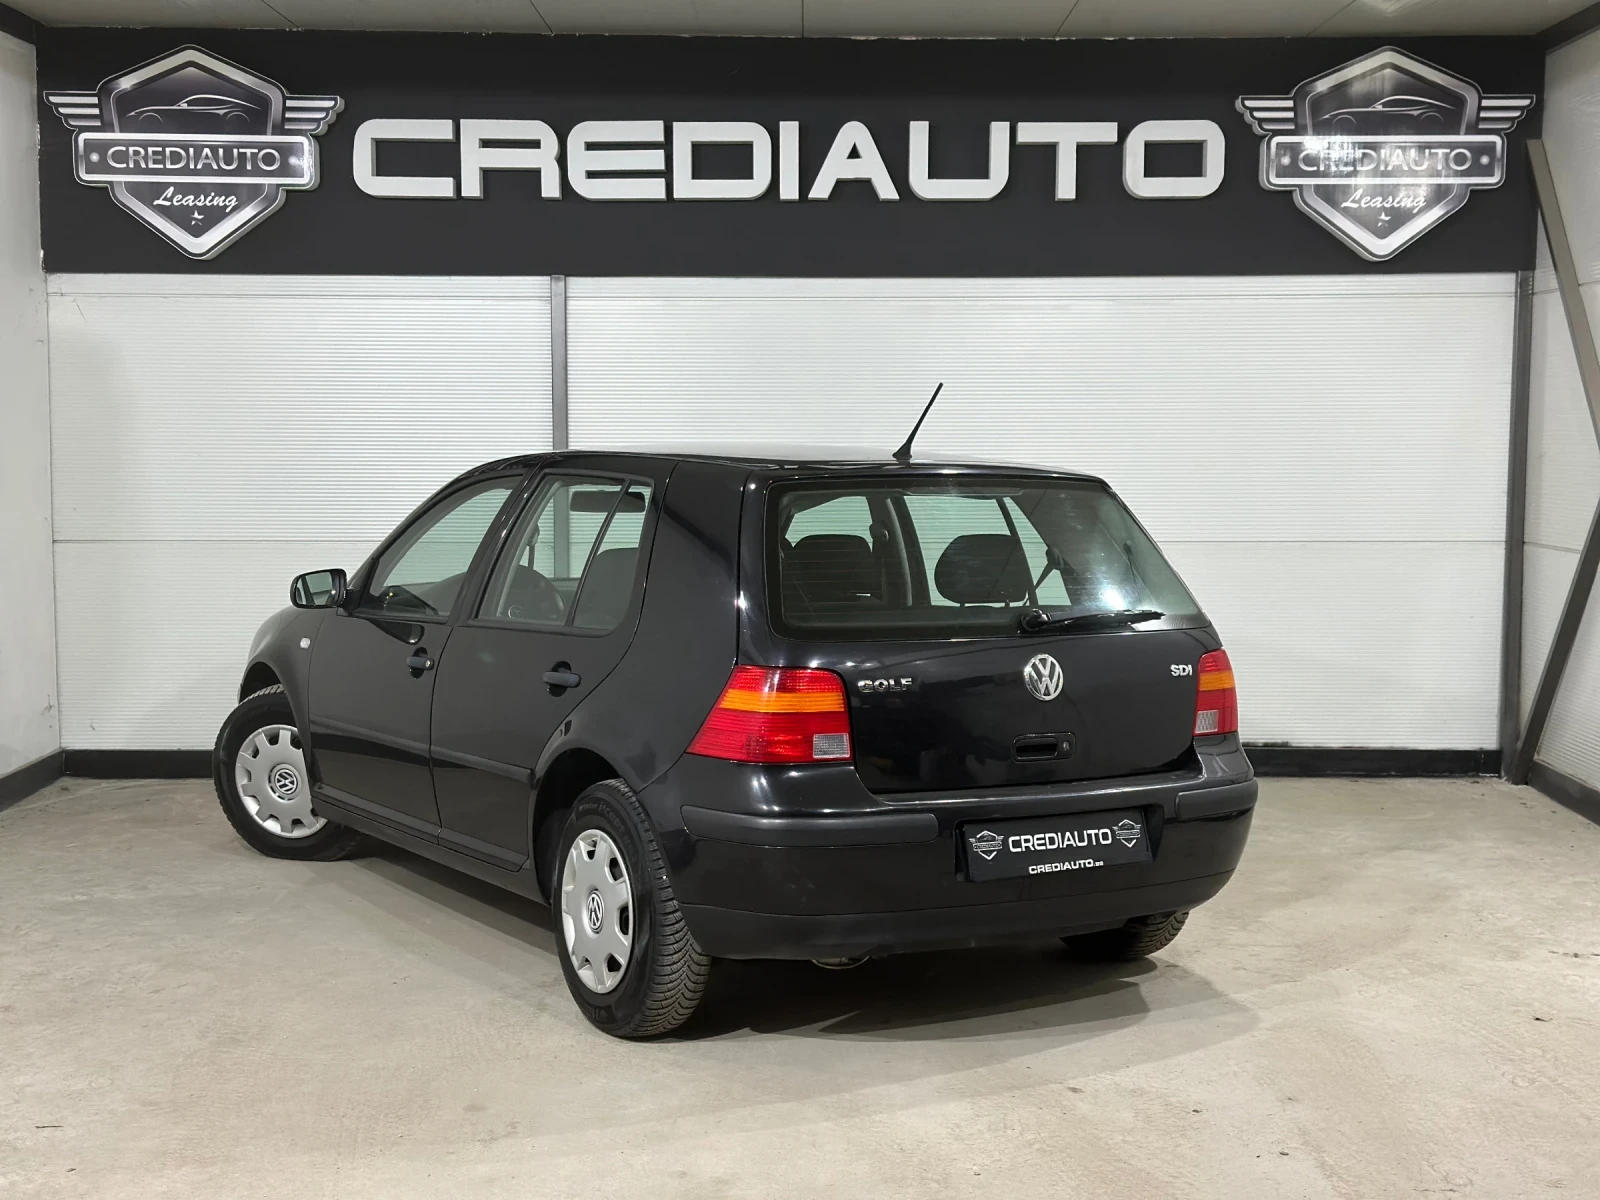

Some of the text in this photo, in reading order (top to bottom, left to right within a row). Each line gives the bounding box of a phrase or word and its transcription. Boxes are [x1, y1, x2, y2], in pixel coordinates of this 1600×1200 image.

[106, 146, 281, 171] CREDIAUTO
[353, 118, 1225, 201] CREDIAUTO
[153, 186, 239, 212] Leasing
[1340, 188, 1427, 213] Leasing
[1170, 664, 1193, 677] SDI
[857, 677, 912, 693] GOLF
[1008, 828, 1112, 852] CREDIAUTO
